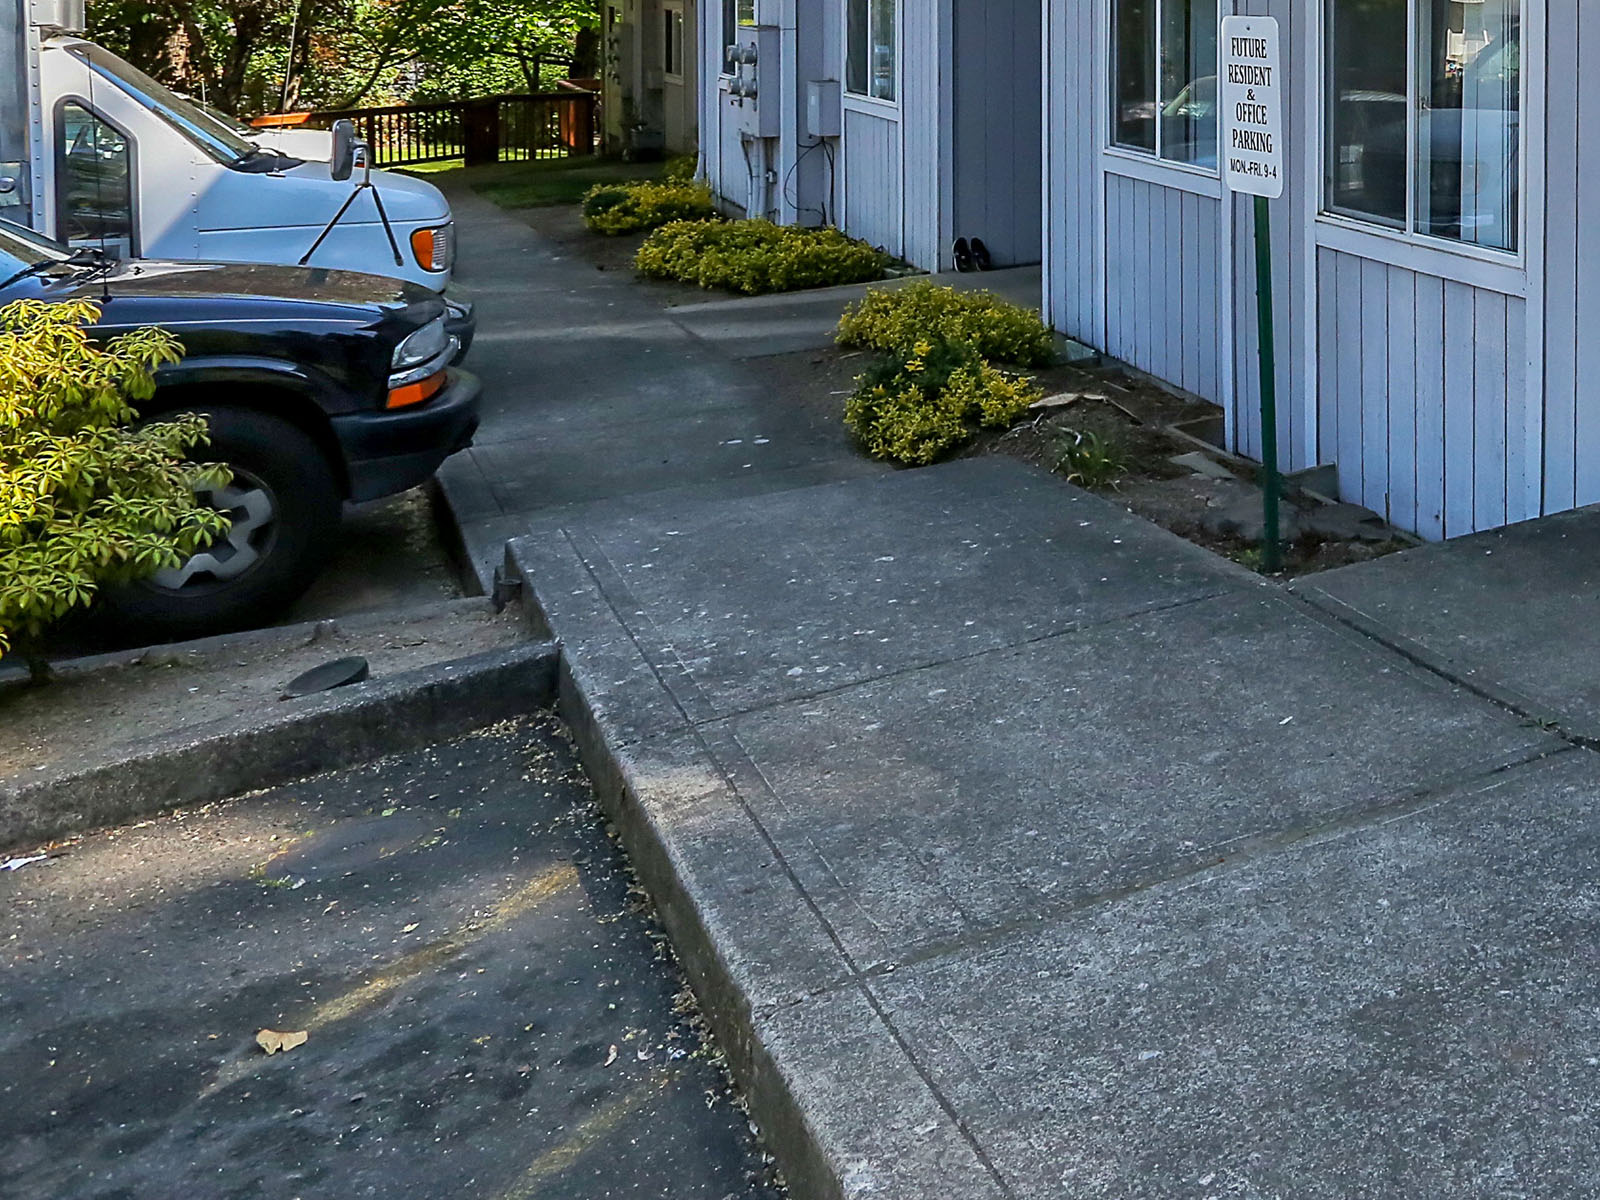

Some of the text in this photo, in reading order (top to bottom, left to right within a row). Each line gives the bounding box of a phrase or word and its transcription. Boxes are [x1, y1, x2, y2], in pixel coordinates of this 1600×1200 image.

[1231, 37, 1267, 58] FUTURE
[1228, 64, 1272, 87] RESIDENT
[1246, 88, 1256, 101] &
[1236, 102, 1267, 125] OFFICE
[1232, 128, 1273, 153] PARKING
[1230, 158, 1263, 177] MON.-FRI.
